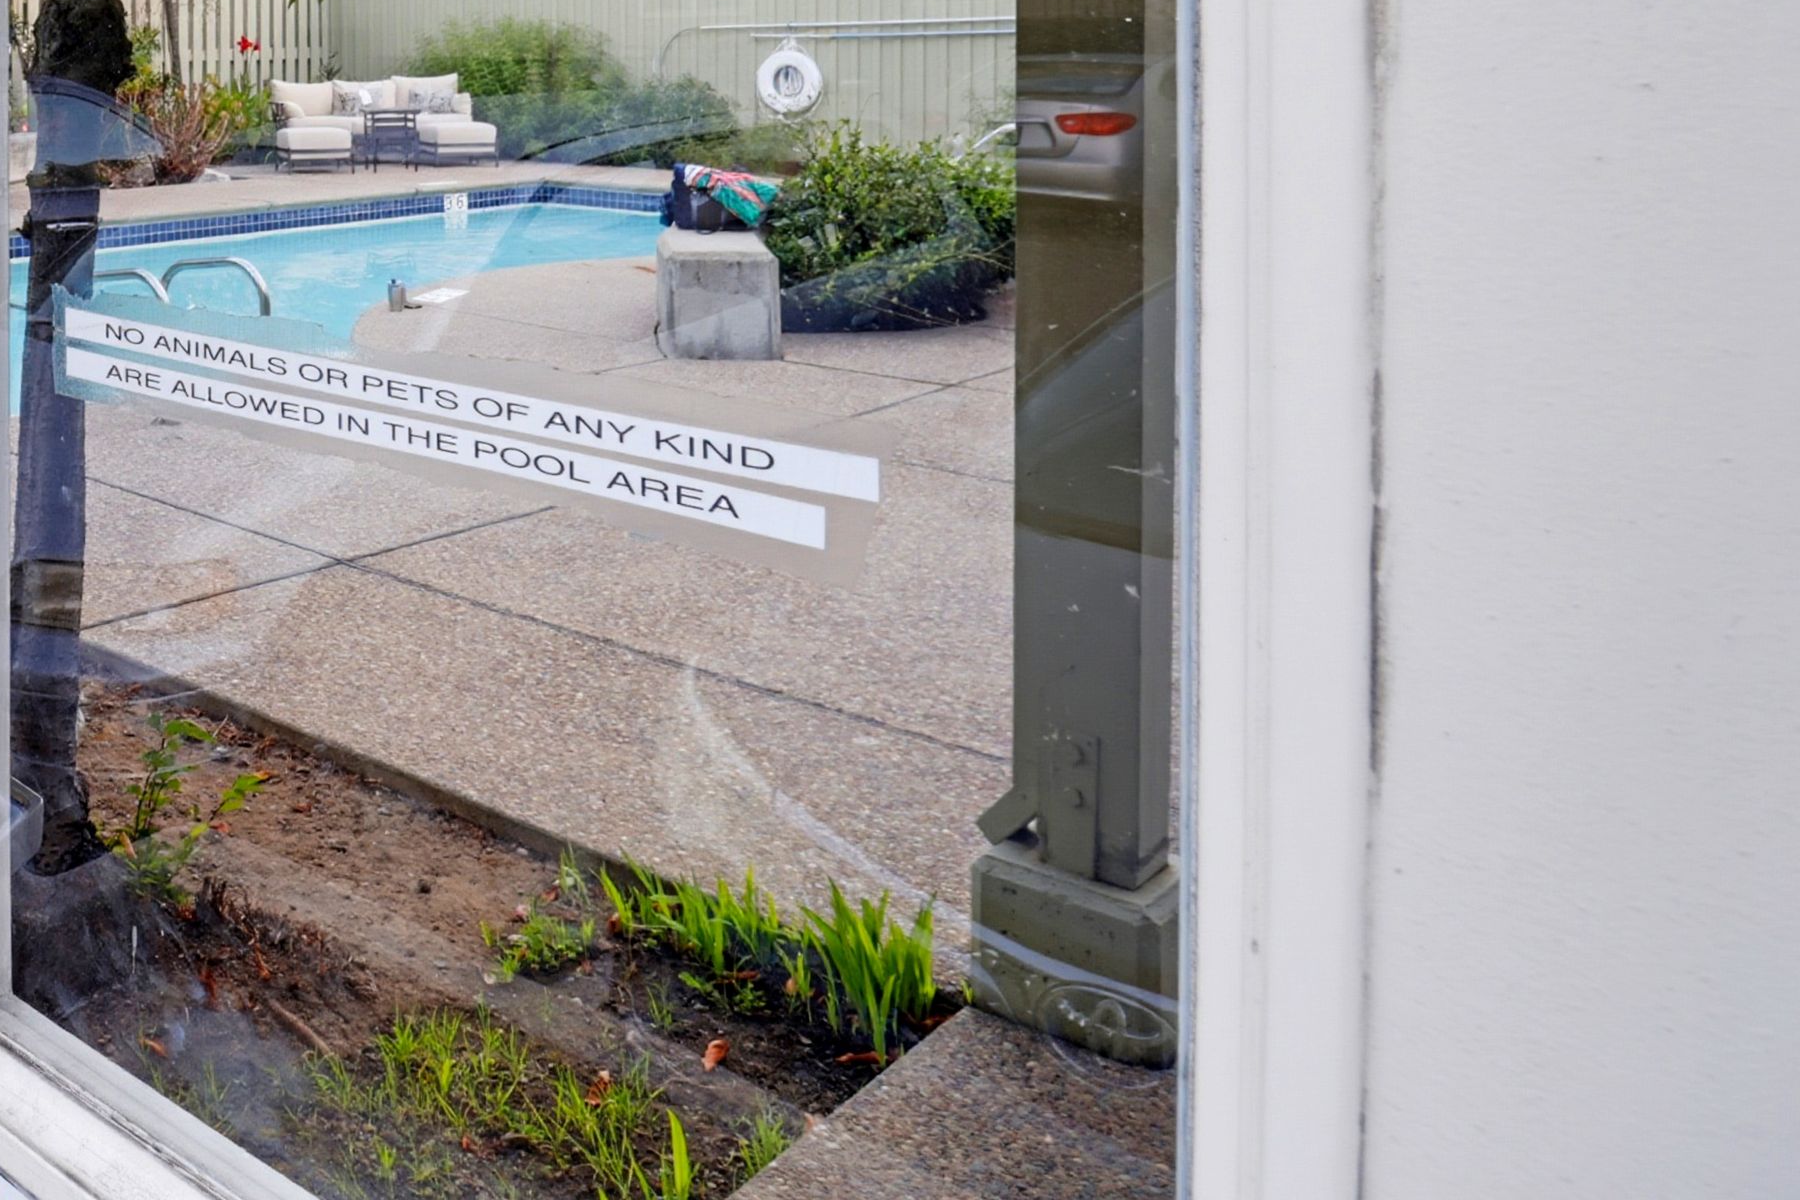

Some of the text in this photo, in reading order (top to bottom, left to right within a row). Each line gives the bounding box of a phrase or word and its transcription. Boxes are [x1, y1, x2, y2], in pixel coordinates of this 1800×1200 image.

[104, 322, 775, 471] NO ANIMALS OR PETS OF ANY KIND
[105, 365, 740, 519] ARE ALLOWED IN THE POOL AREA
